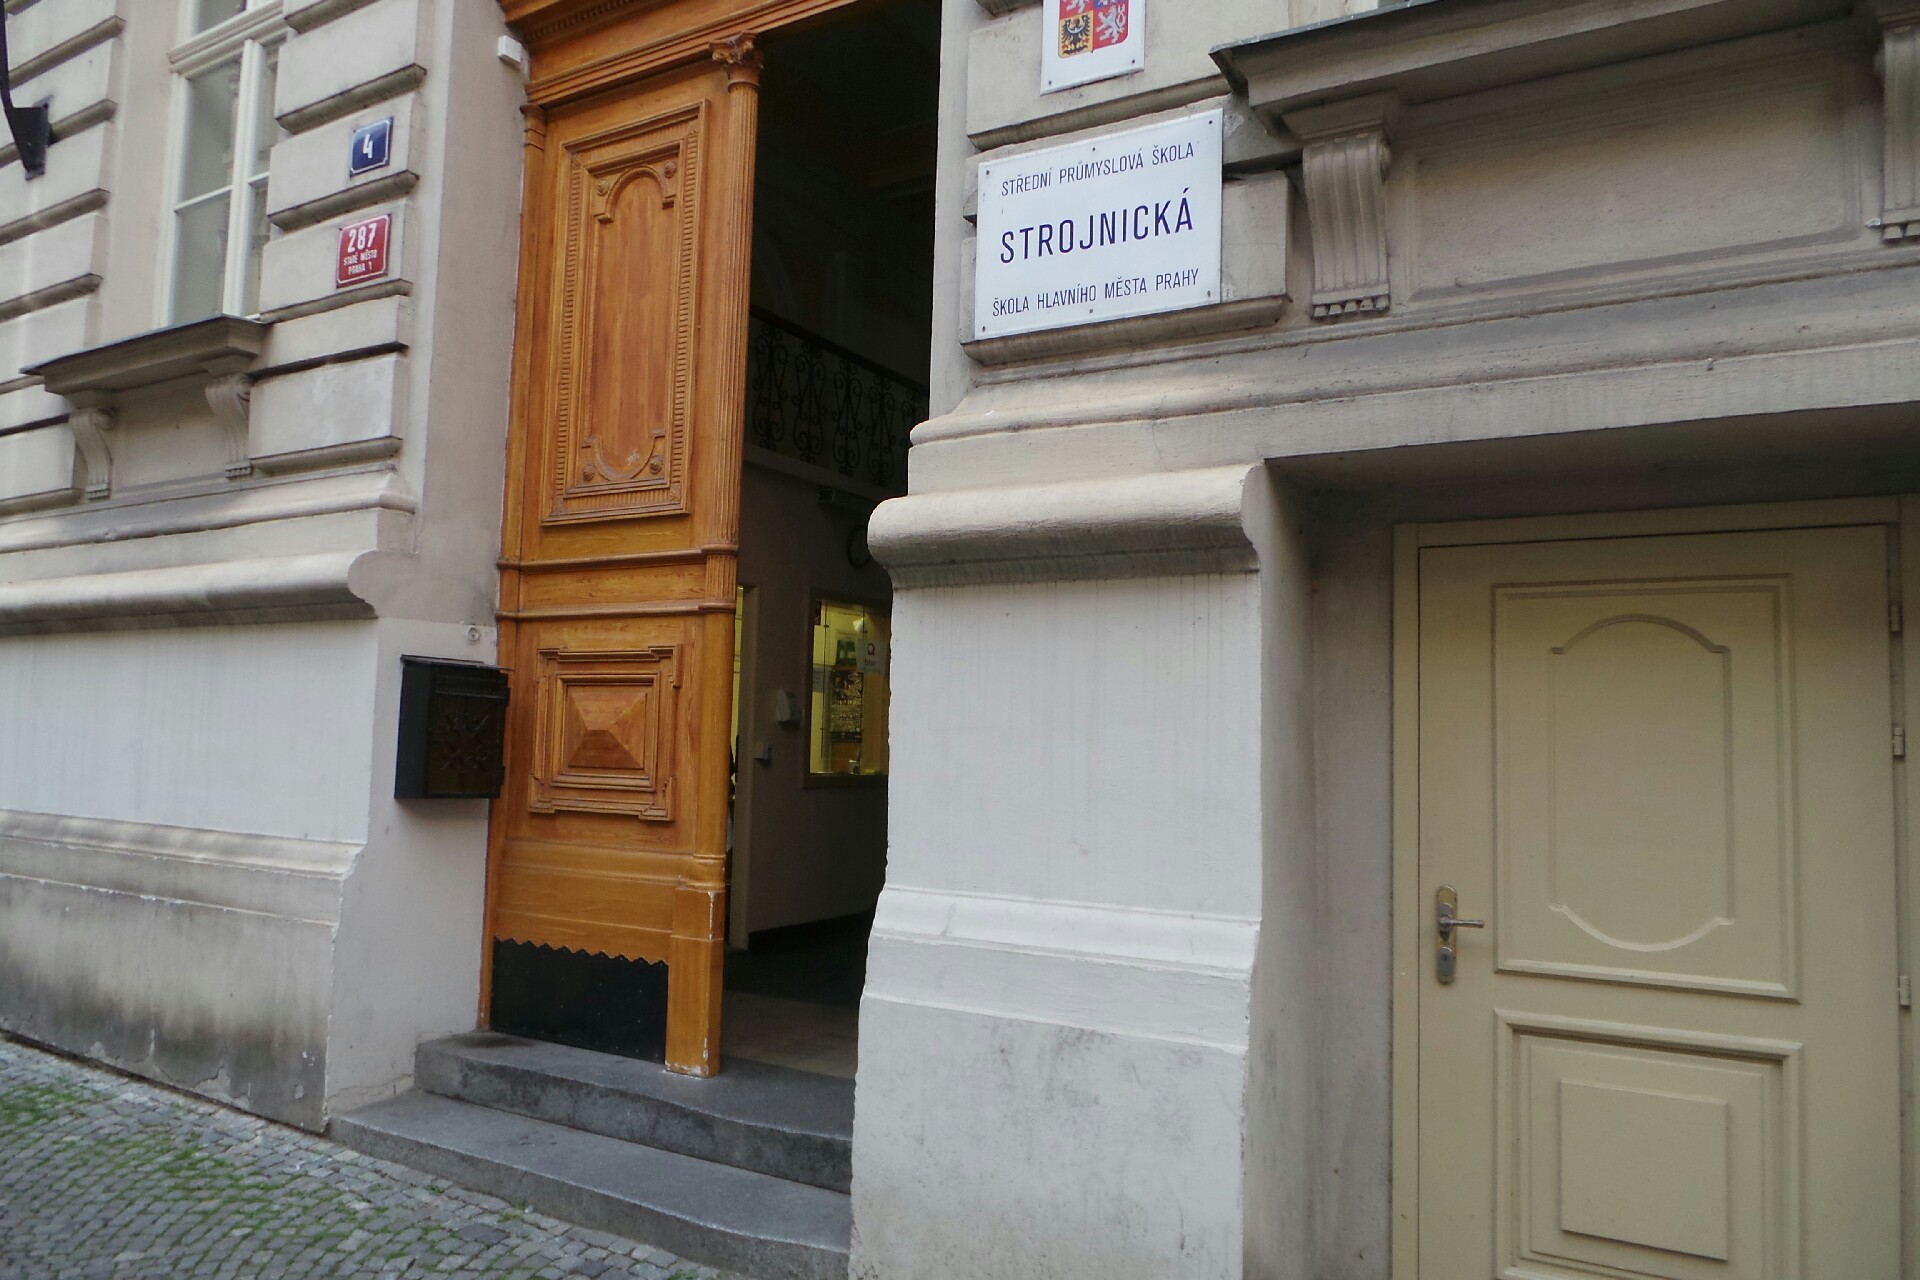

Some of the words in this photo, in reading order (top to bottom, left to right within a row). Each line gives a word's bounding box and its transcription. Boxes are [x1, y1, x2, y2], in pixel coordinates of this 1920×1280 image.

[362, 133, 374, 159] 4
[1001, 167, 1052, 197] STŘEDNÍ
[1059, 148, 1144, 185] PRŮMYSLOVÁ
[1151, 141, 1194, 166] ŠKOLA
[347, 223, 376, 253] 287
[1000, 187, 1193, 264] STROJNICKÁ
[992, 295, 1030, 317] ŠKOLA
[1037, 283, 1097, 310] HLAVNÍHO
[1104, 276, 1147, 300] MĚSTA
[1155, 267, 1199, 292] PRAHY
